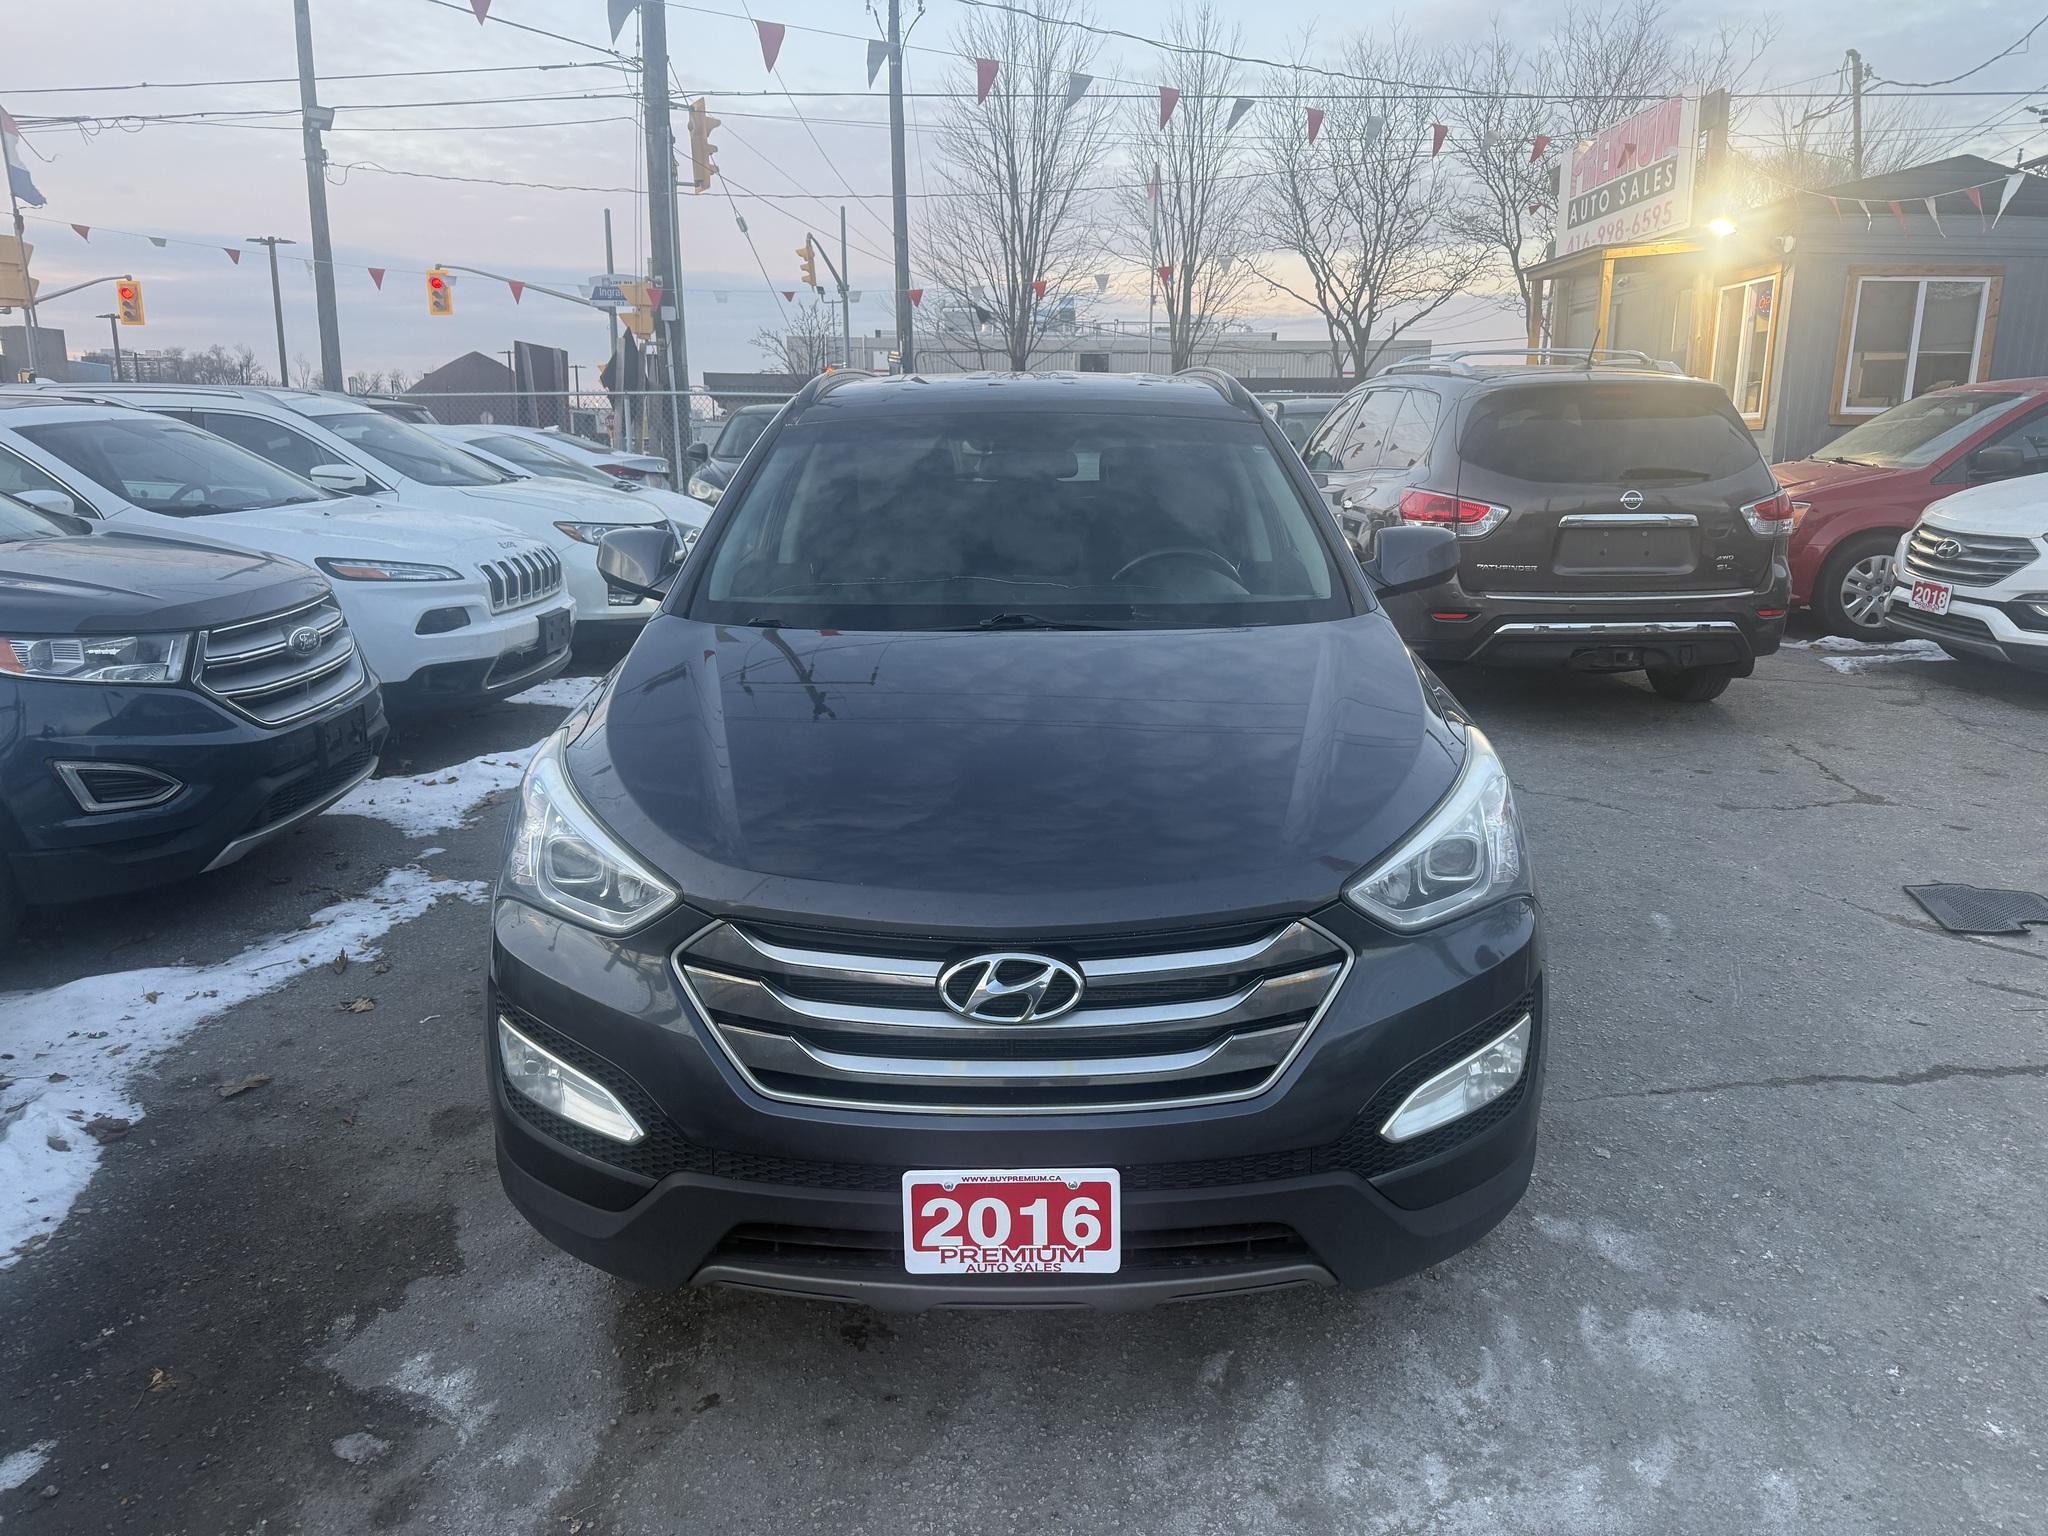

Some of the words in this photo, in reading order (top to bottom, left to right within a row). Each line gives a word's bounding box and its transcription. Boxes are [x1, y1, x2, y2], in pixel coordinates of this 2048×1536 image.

[1570, 93, 1683, 198] PREMIUM
[1569, 189, 1610, 225] AUTO
[1619, 163, 1673, 205] SALES
[1567, 200, 1673, 253] 416-998-6595
[1476, 563, 1538, 572] PATHFINDER
[1913, 585, 1947, 607] 2018
[961, 1175, 1062, 1183] WWW.BUYPREMIUM.CA
[921, 1197, 1102, 1247] 2016
[939, 1245, 1086, 1264] PREMIUM
[965, 1263, 1009, 1273] AUTO
[1014, 1263, 1062, 1273] SALES
